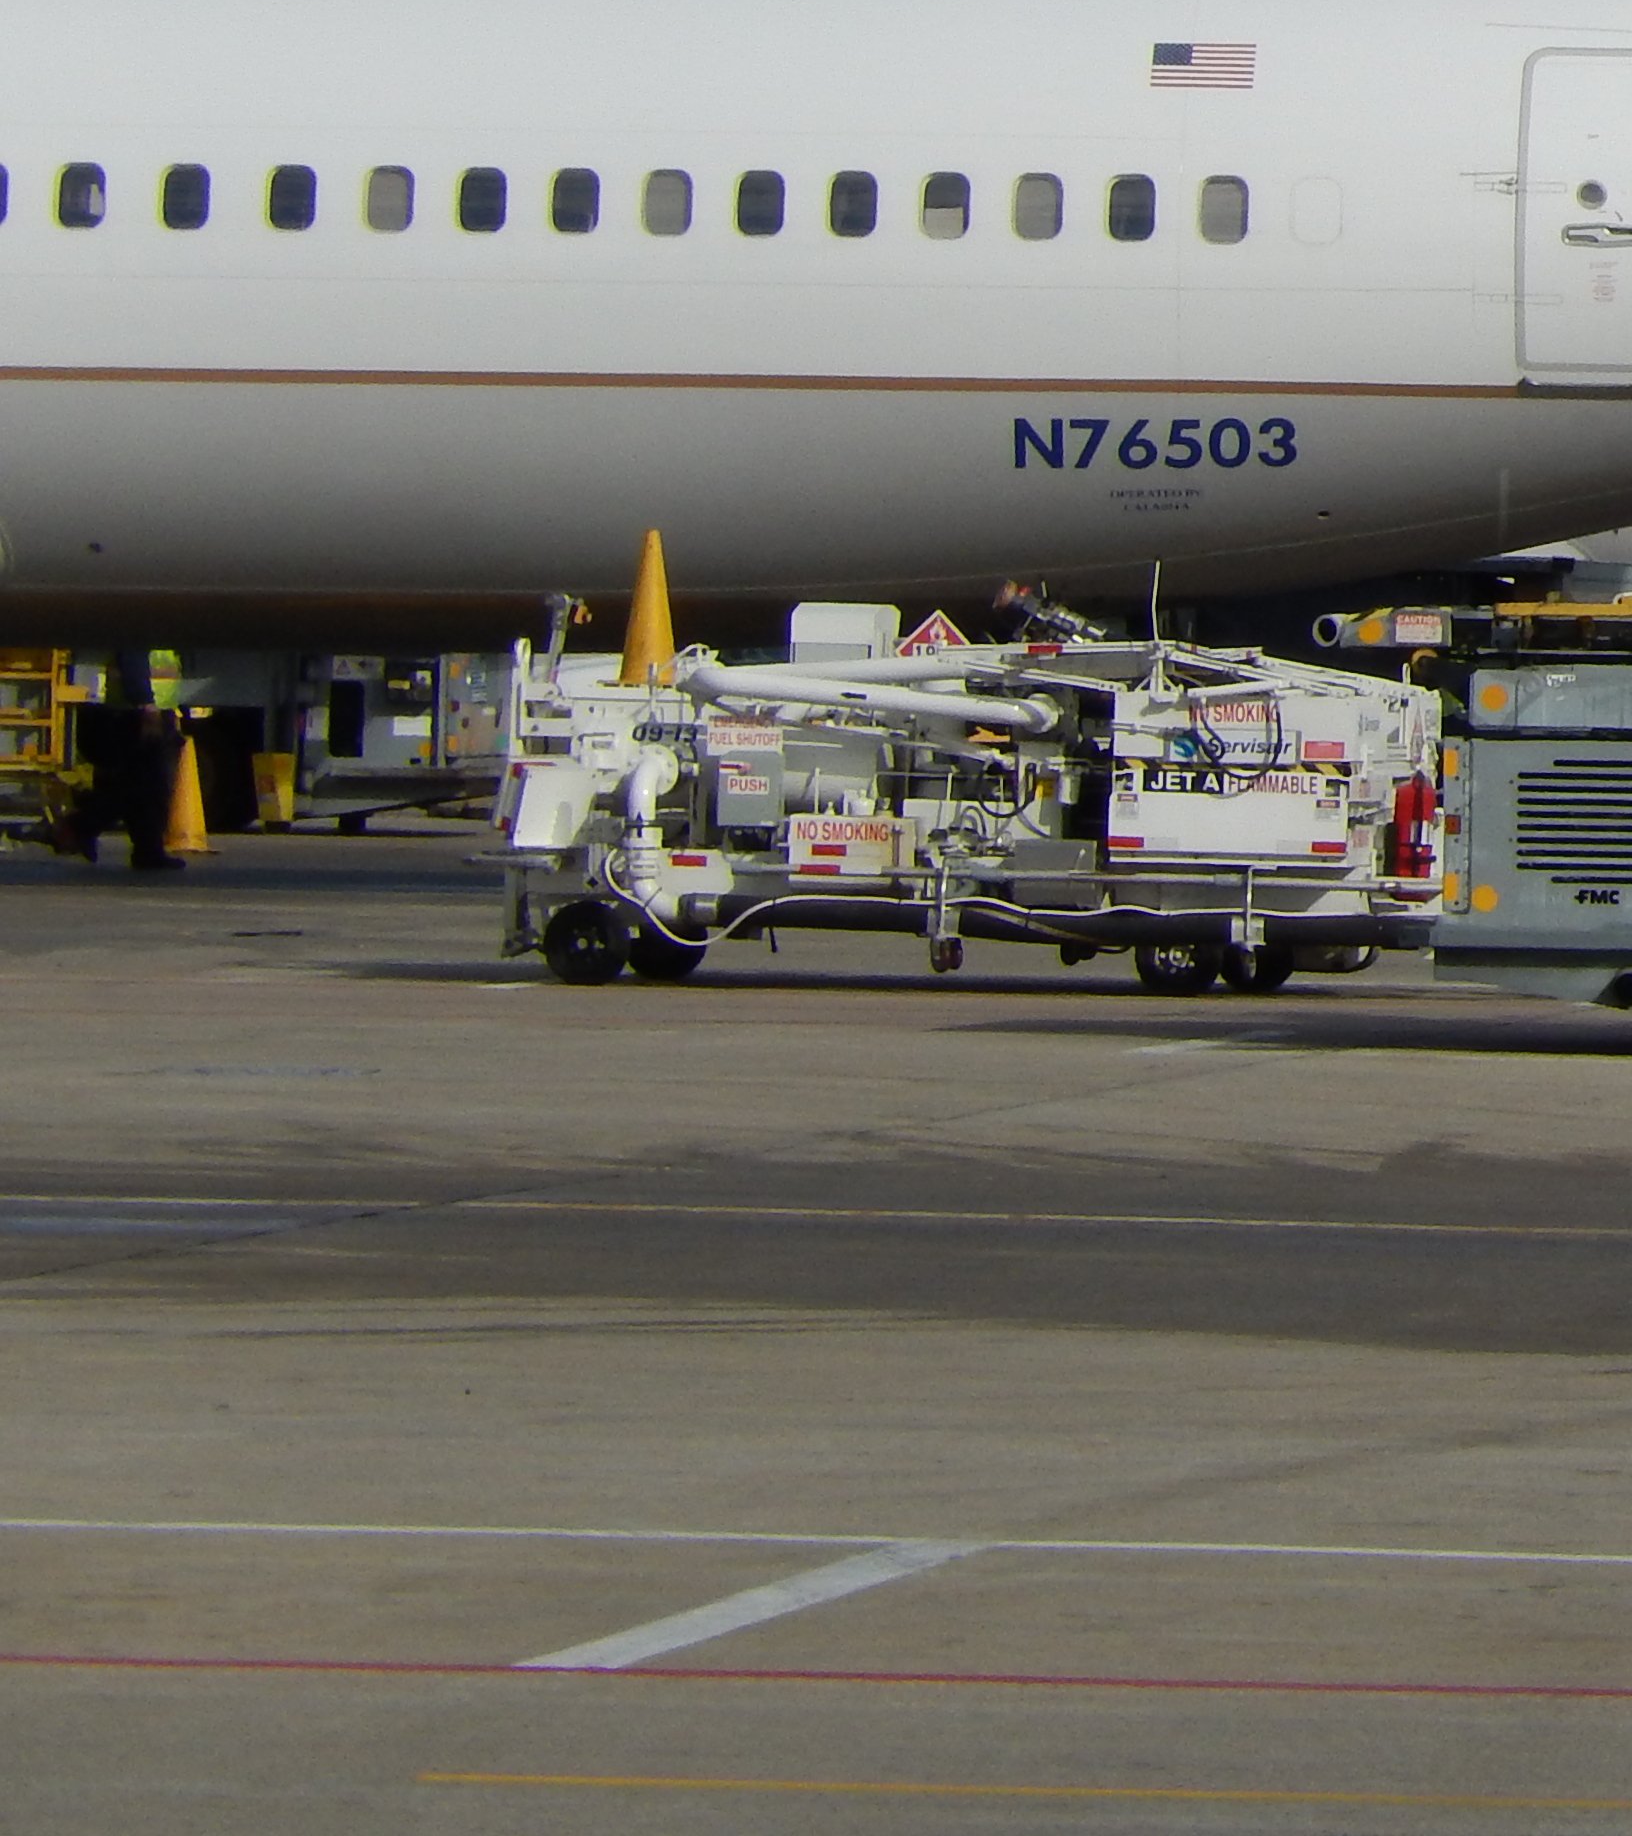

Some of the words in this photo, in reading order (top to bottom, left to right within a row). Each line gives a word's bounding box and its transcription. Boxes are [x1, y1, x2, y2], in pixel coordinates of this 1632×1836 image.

[1013, 417, 1298, 469] N76503
[1213, 703, 1281, 723] SMOKING
[709, 732, 732, 744] FUEL
[736, 732, 781, 746] SHUTOFF
[730, 778, 768, 791] PUSH
[1151, 771, 1198, 791] JET
[1202, 772, 1220, 792] A
[1228, 774, 1318, 795] FLAMMABLE
[796, 820, 818, 839] NO
[822, 821, 889, 842] SMOKING
[1575, 890, 1621, 904] FMC
